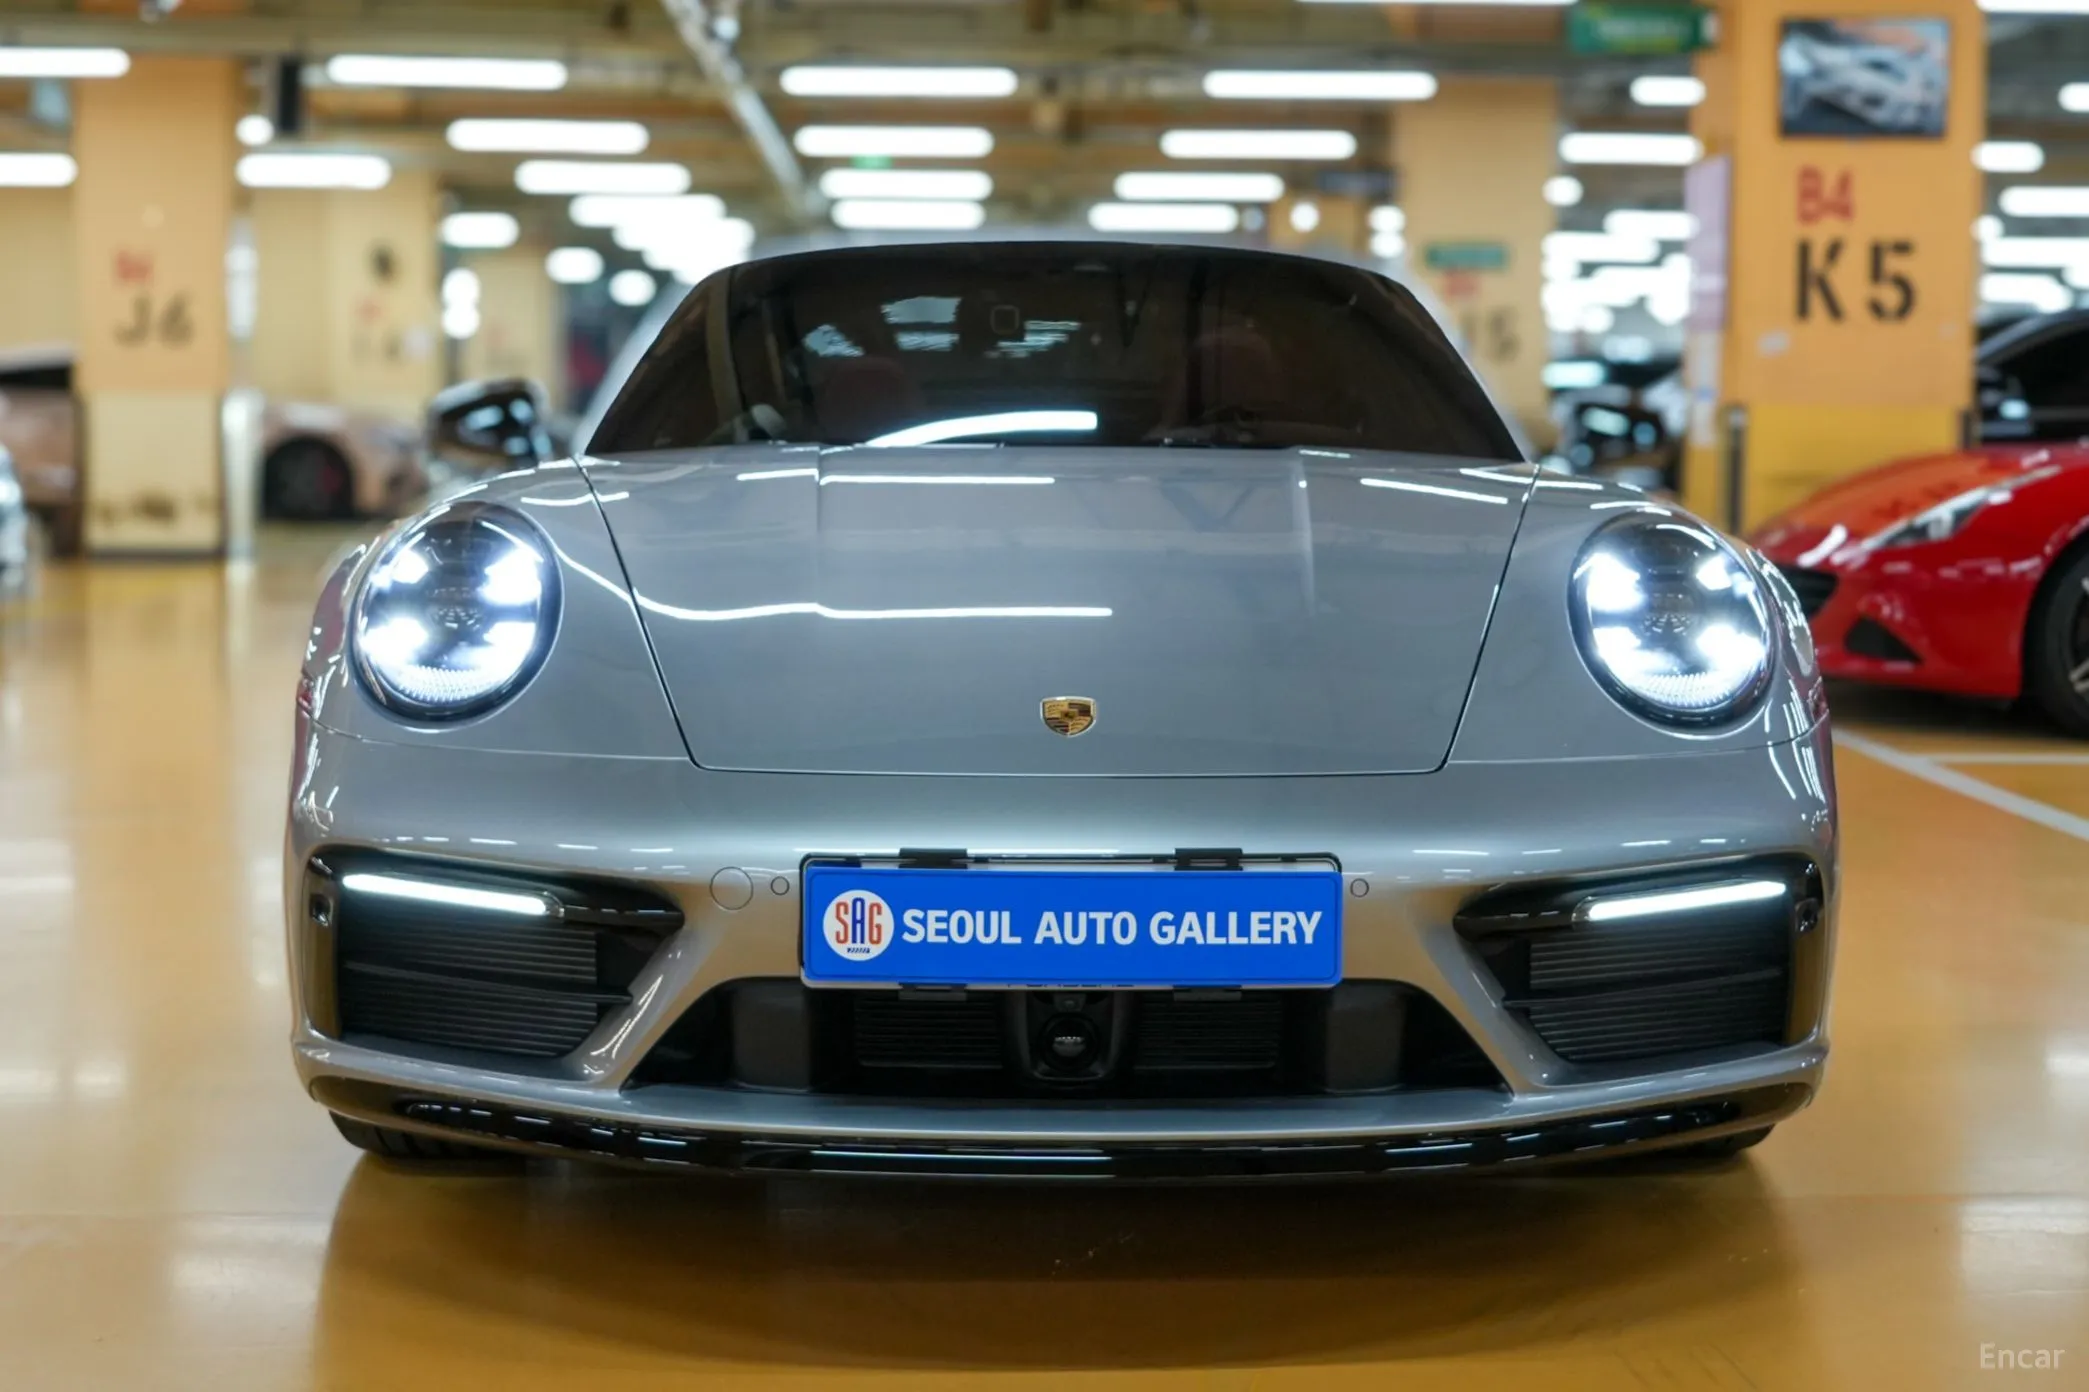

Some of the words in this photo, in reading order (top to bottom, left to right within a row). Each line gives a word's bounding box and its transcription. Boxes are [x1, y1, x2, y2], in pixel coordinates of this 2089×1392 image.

[1796, 165, 1855, 224] B4
[835, 897, 882, 945] SAG
[902, 908, 1021, 944] SEOUL
[1034, 911, 1137, 945] AUTO
[1150, 911, 1322, 945] GALLERY
